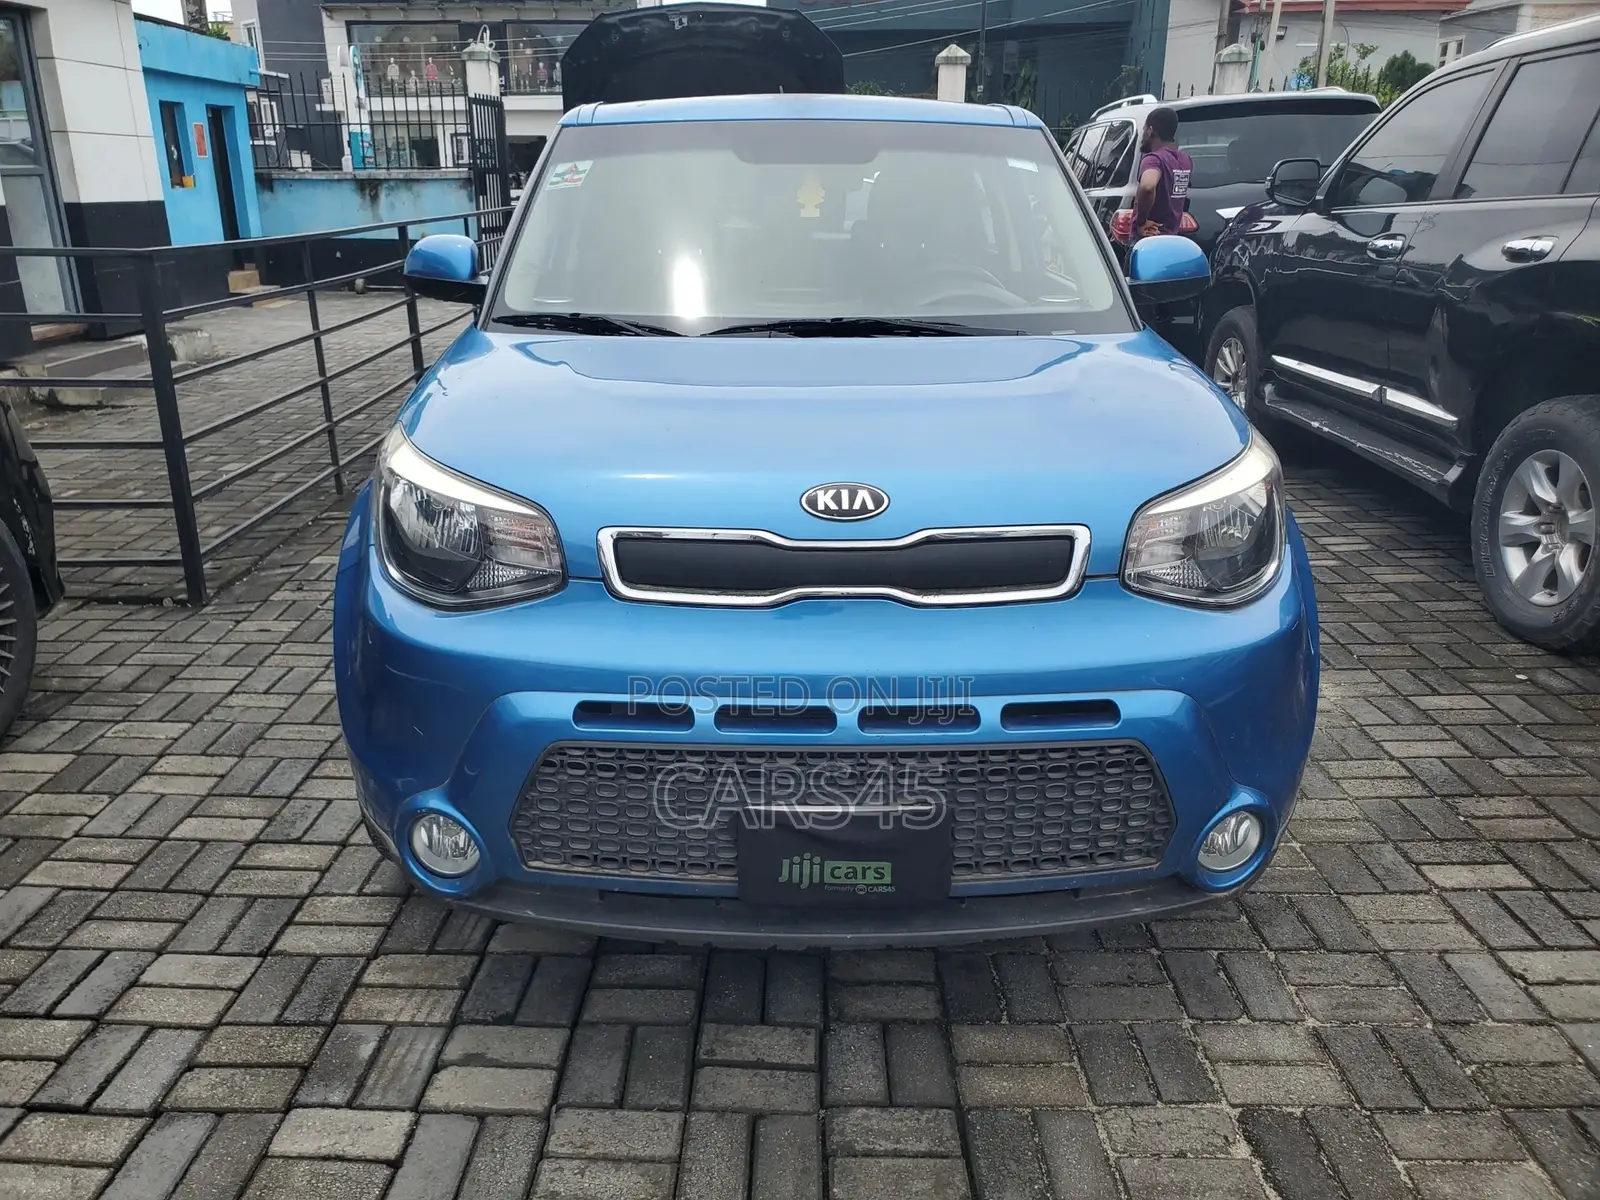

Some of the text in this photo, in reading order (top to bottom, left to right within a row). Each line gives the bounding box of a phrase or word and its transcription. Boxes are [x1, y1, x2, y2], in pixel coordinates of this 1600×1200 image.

[816, 489, 875, 510] KIA
[829, 865, 885, 880] cars
[867, 885, 896, 893] CARS45
